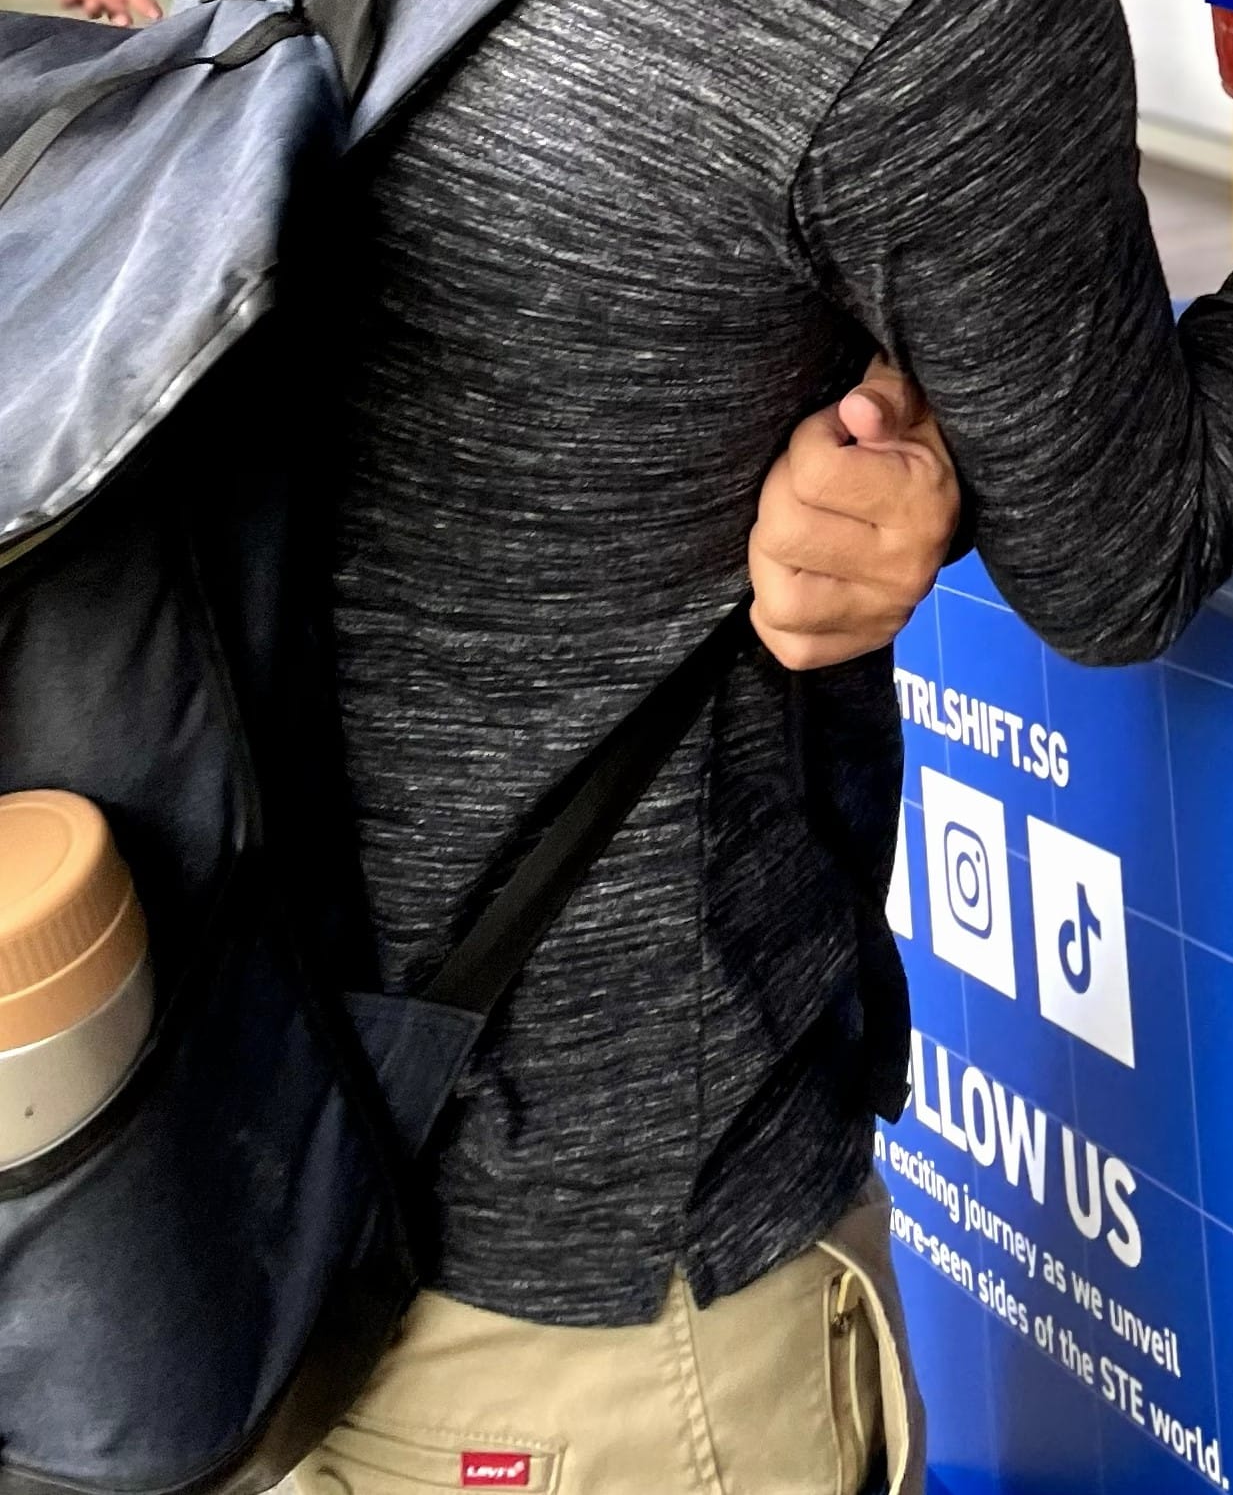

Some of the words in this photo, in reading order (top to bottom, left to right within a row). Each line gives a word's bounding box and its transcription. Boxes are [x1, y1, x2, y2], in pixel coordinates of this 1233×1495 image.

[893, 666, 1070, 788] TRLSHIFT.SG
[890, 1141, 960, 1224] exciting
[963, 1184, 1037, 1279] journey
[1043, 1252, 1067, 1294] as
[1072, 1271, 1104, 1321] we
[1109, 1298, 1182, 1379] unveil
[904, 1028, 1047, 1205] LLOW
[1062, 1124, 1142, 1268] US
[978, 1269, 1029, 1334] sides
[1034, 1315, 1054, 1354] of
[1059, 1329, 1094, 1385] the
[1100, 1356, 1145, 1426] STE
[1149, 1401, 1230, 1490] world.
